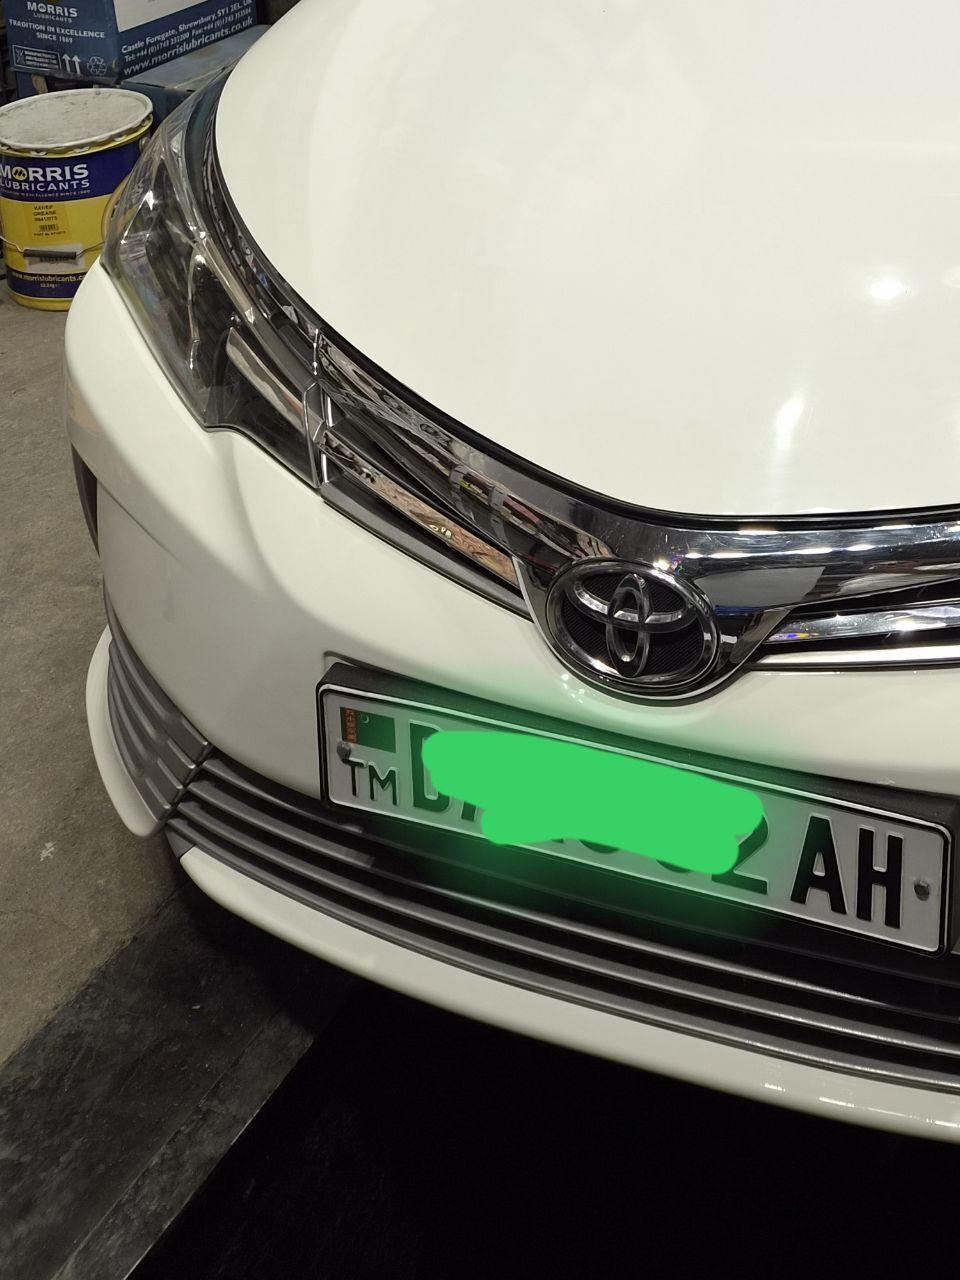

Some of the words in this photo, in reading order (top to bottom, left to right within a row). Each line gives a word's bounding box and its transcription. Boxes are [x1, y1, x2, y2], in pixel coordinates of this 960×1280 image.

[27, 1, 79, 18] MORRIS
[9, 18, 46, 30] TRADITION
[56, 26, 106, 39] EXCELLENCE
[36, 32, 57, 41] SINCE
[121, 39, 145, 54] Castle
[123, 16, 254, 76] www.morrislubricants.co.uk
[0, 163, 89, 181] MORRIS
[0, 178, 90, 192] LUBRICANTS
[341, 757, 397, 806] TM
[790, 815, 904, 929] AH
